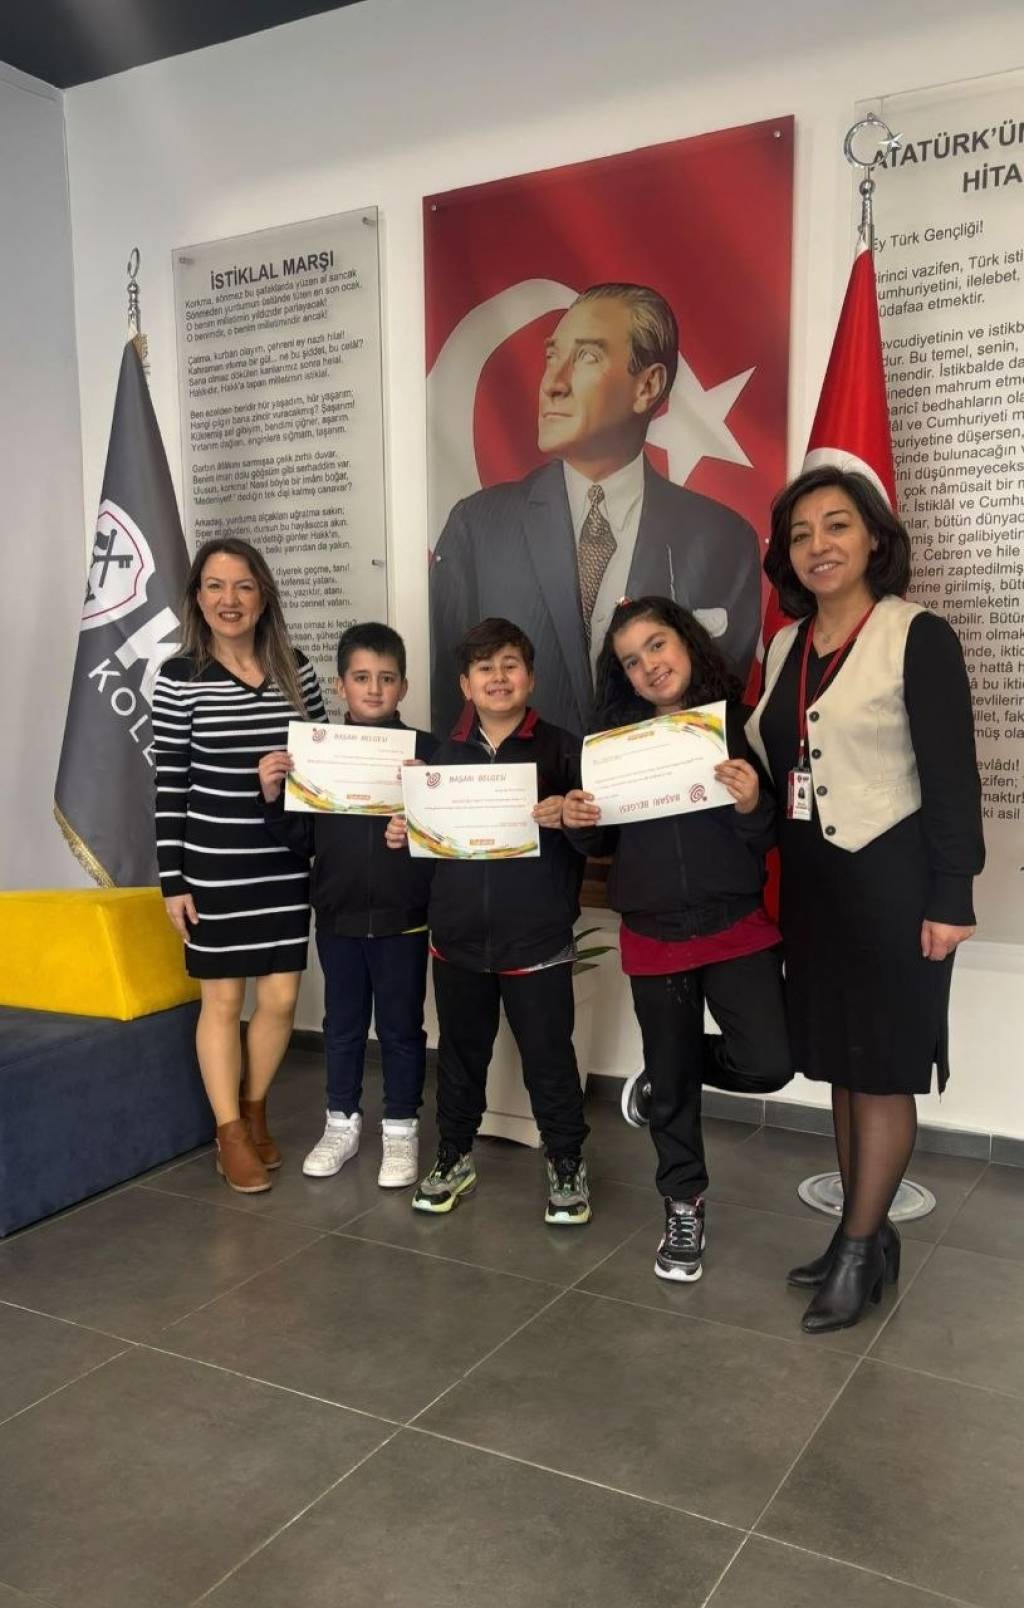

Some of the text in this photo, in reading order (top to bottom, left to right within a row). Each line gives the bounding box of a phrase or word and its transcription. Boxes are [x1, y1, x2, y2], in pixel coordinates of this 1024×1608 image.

[890, 232, 920, 247] Türk
[924, 221, 984, 242] Gençliği!
[210, 250, 334, 290] İSTİKLAL MARŞI
[876, 266, 908, 284] irinci
[912, 261, 964, 278] vazifen,
[968, 253, 1000, 270] Türk
[878, 277, 962, 300] umhuriyetini,
[879, 293, 984, 317] üdafaa etmektir.
[968, 330, 984, 339] ve
[910, 352, 926, 363] Bu
[932, 346, 970, 361] temel,
[977, 341, 1018, 355] senin,
[940, 359, 1004, 377] İstikbalde
[936, 380, 991, 394] mahrum
[922, 396, 1002, 413] bedhahların
[907, 422, 922, 431] ve
[927, 409, 1008, 429] Cumhuriyeti
[934, 445, 1016, 462] bulunacağın
[904, 478, 1014, 500] çok nâmüsait bir
[960, 501, 975, 509] ve
[934, 514, 970, 527] bütün
[938, 532, 954, 543] bir
[924, 544, 1020, 561] Cebren ve hile
[912, 565, 944, 578] leleri
[910, 581, 940, 594] erine
[945, 579, 995, 595] girilmiş,
[943, 594, 1020, 609] memleketin
[980, 661, 1013, 673] hattâ
[984, 678, 998, 690] bu
[998, 808, 1020, 820] asil
